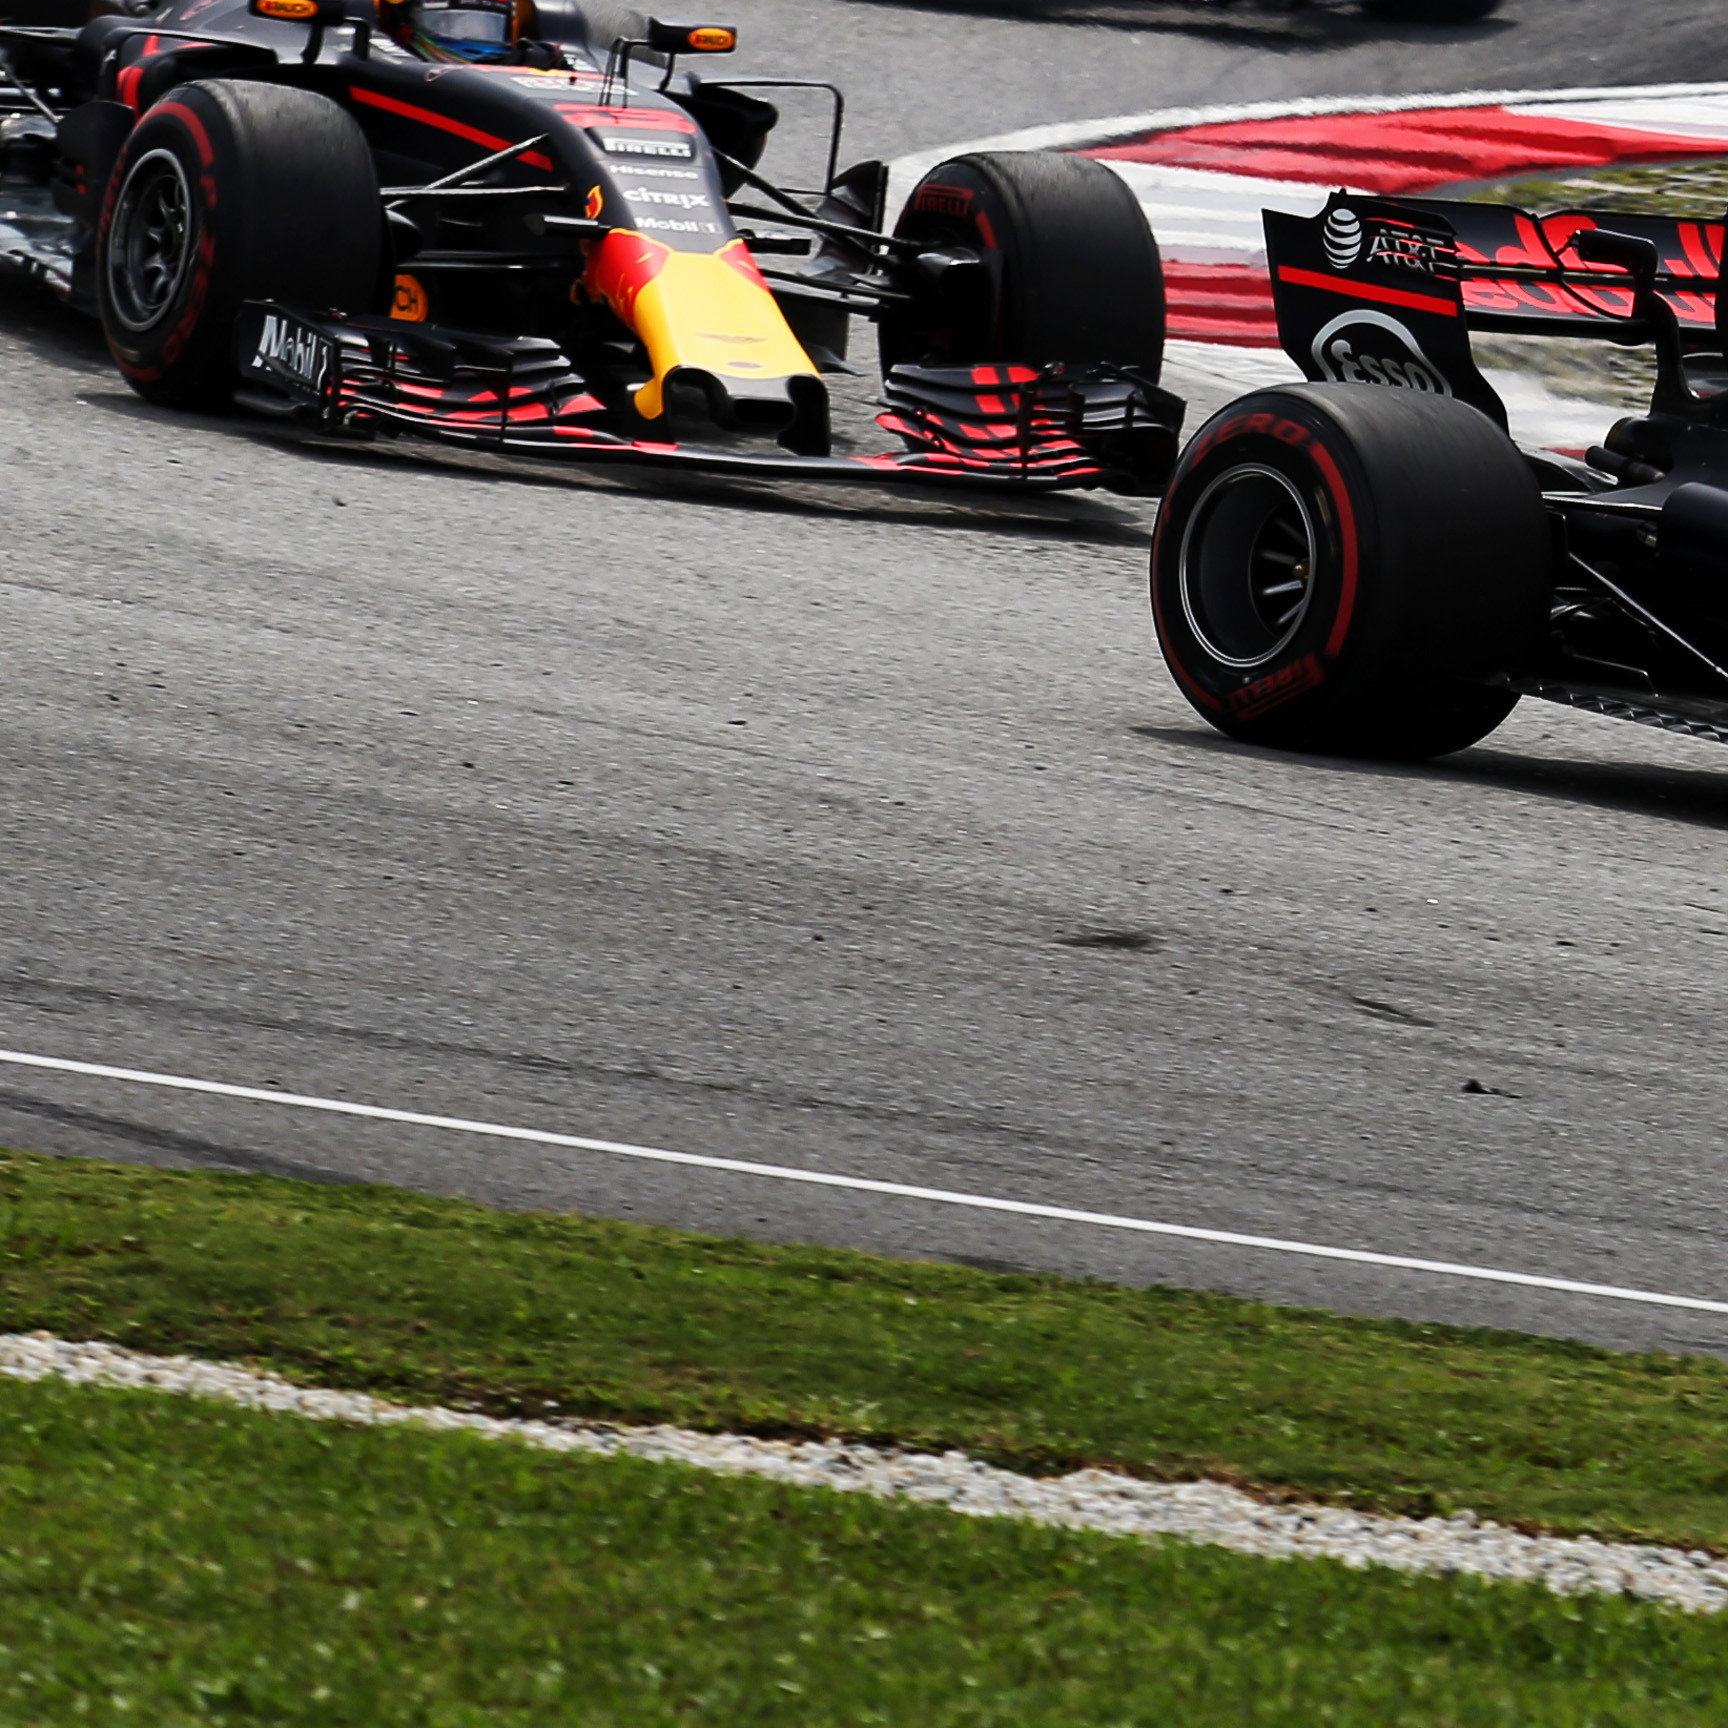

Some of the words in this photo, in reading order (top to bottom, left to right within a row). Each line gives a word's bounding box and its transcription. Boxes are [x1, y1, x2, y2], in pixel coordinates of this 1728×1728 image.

[603, 137, 692, 158] PIRELLI
[609, 164, 699, 180] Hisense
[633, 217, 698, 233] Mobil
